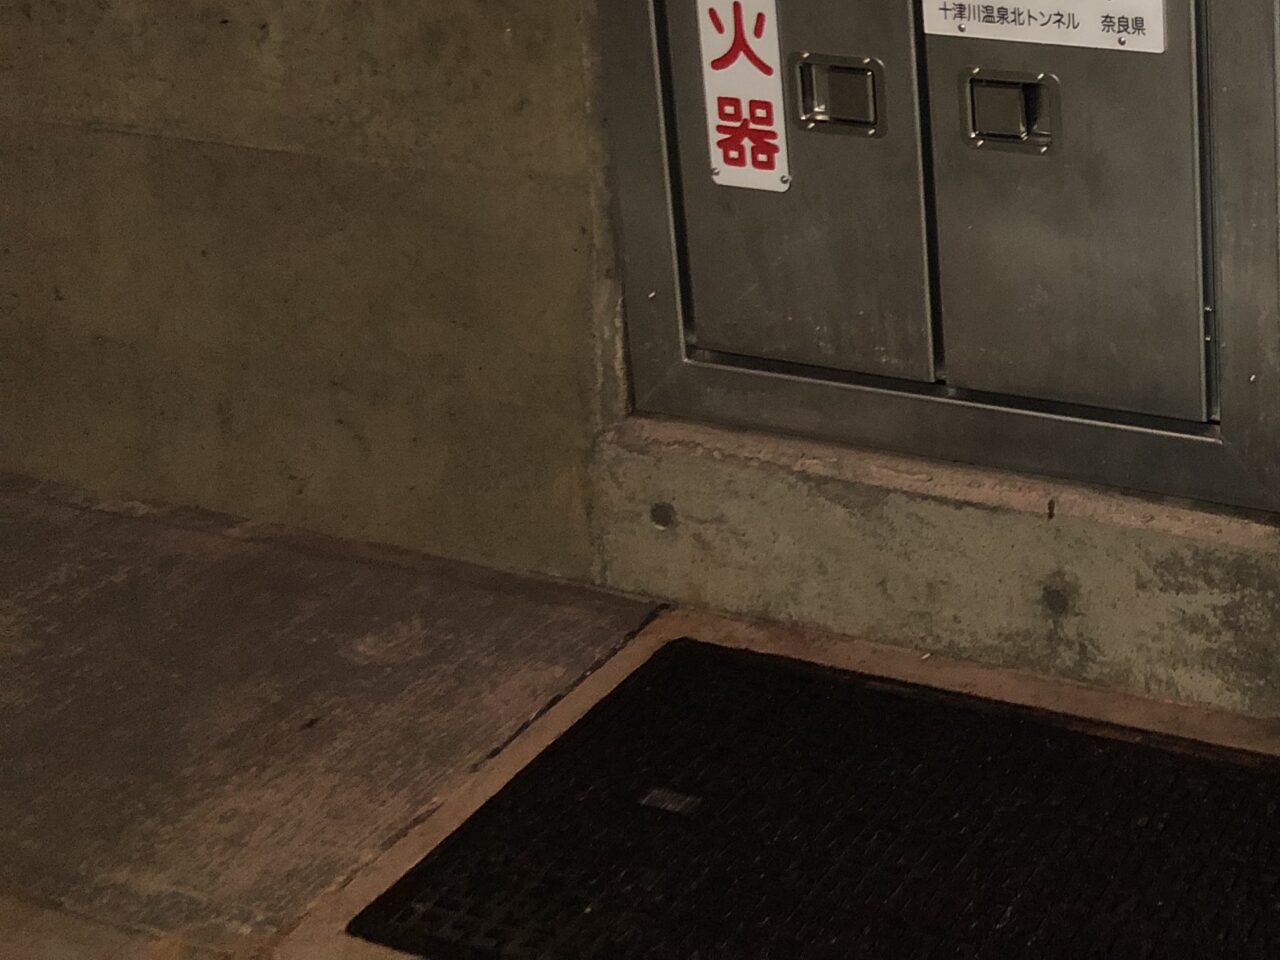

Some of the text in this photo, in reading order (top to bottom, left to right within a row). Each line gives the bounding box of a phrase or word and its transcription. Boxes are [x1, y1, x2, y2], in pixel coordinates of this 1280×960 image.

[938, 1, 1147, 37] 十津川温泉北トンネル 奈良県
